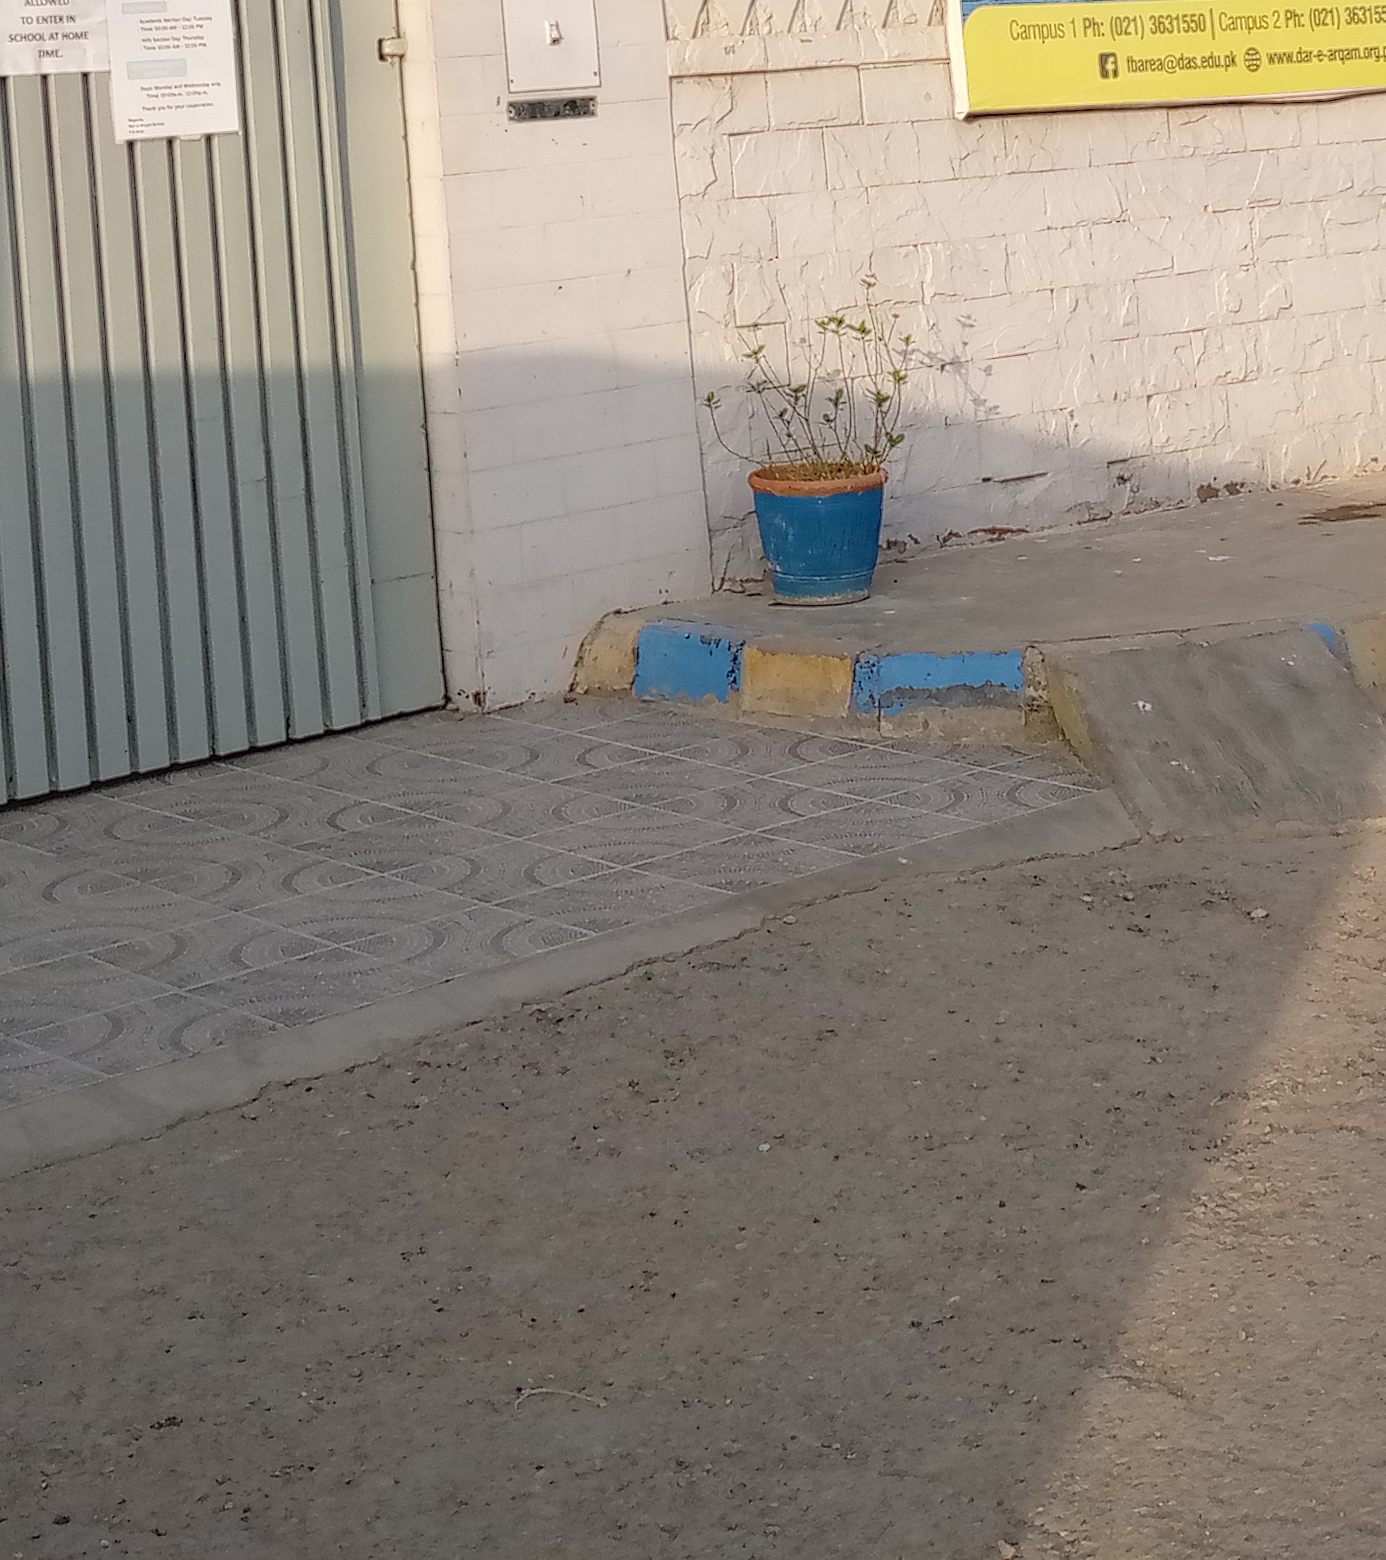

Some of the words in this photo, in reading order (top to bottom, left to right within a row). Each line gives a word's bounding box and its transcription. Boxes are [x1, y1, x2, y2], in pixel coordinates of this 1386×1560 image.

[20, 16, 33, 25] TO
[36, 15, 64, 24] ENTER
[66, 15, 76, 23] IN
[1219, 11, 1269, 34] Campus
[1272, 10, 1282, 29] 2
[1285, 9, 1305, 28] Ph:
[1309, 6, 1340, 32] (021)
[1009, 19, 1065, 44] Campus
[1069, 18, 1077, 38] 1
[1083, 17, 1105, 38] Ph:
[1110, 15, 1145, 41] (021)
[1149, 14, 1206, 35] 3631550
[8, 33, 46, 43] SCHOOL
[48, 32, 60, 41] AT
[61, 31, 89, 40] HOME
[37, 49, 63, 58] TIME.
